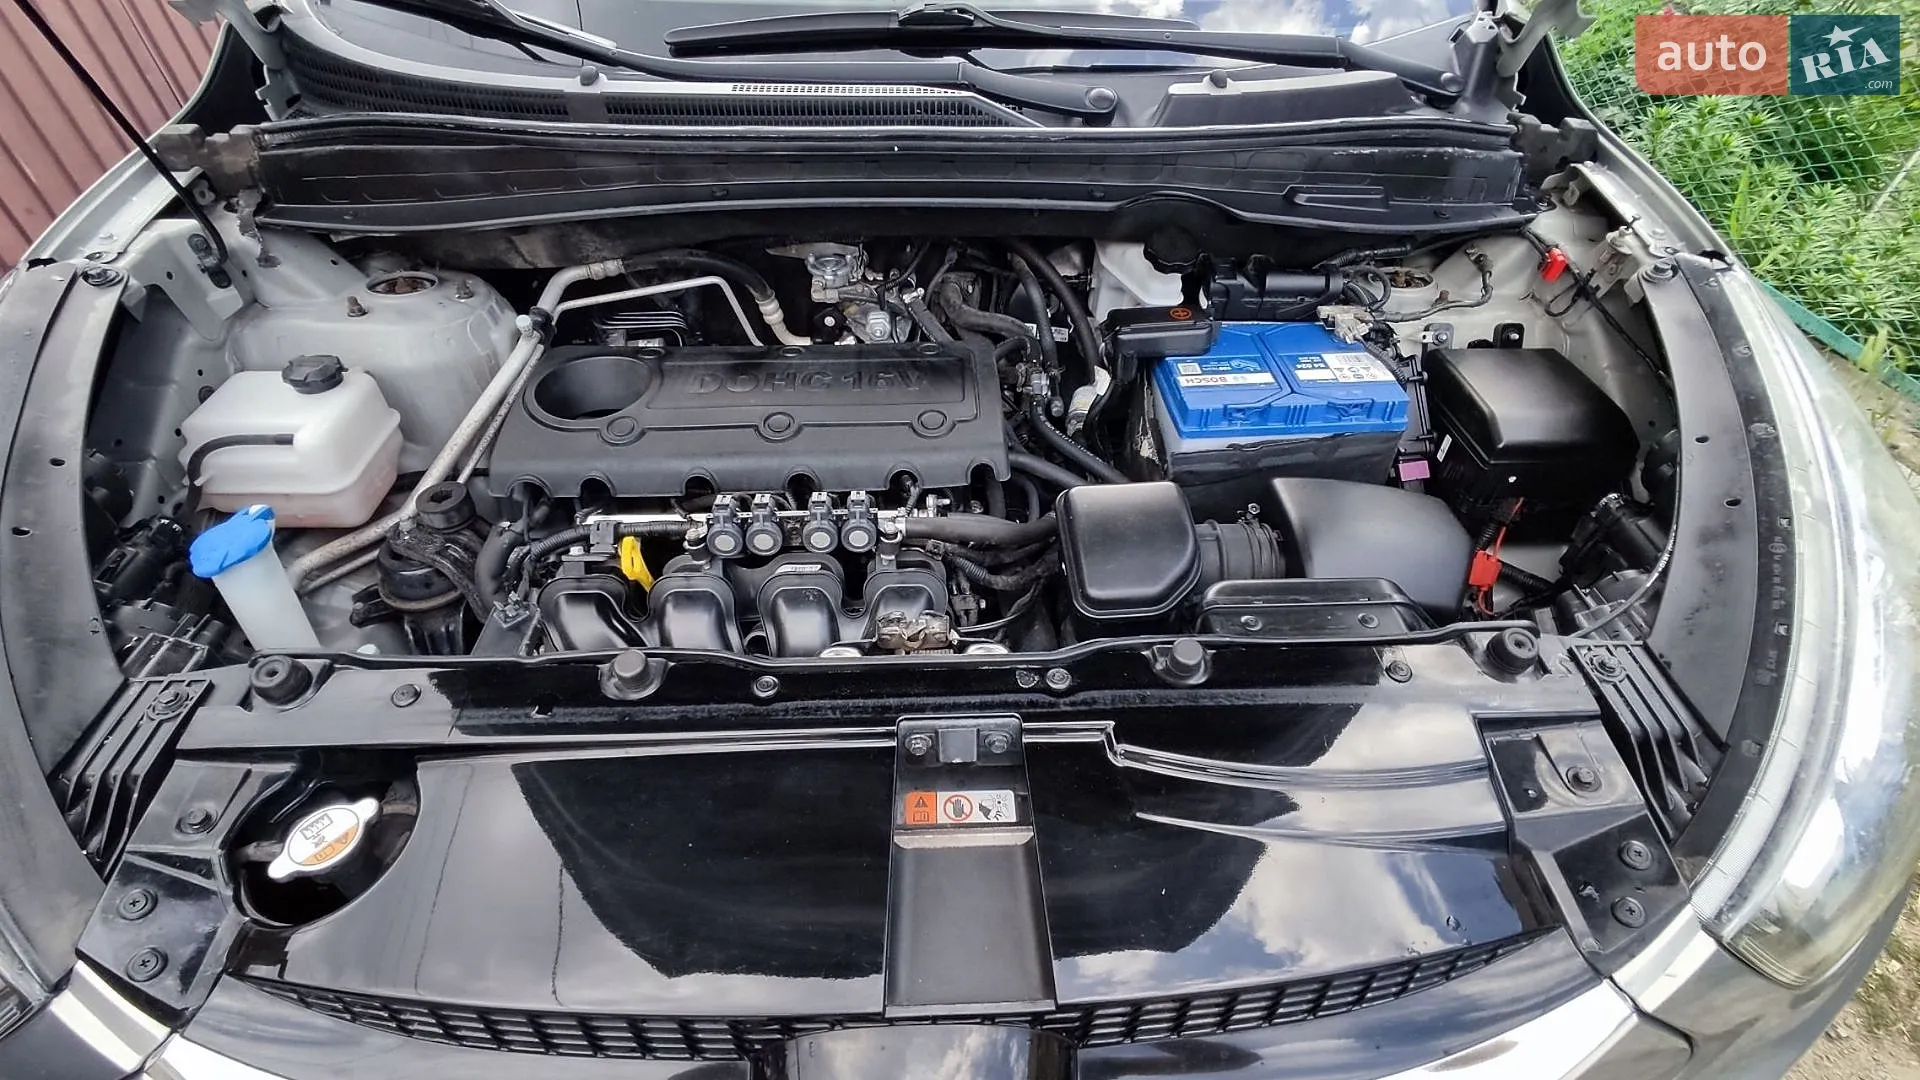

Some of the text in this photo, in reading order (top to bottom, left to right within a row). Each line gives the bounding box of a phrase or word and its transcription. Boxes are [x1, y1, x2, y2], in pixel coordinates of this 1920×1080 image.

[687, 369, 929, 394] DOHC 16V
[1184, 376, 1228, 384] BOSCH
